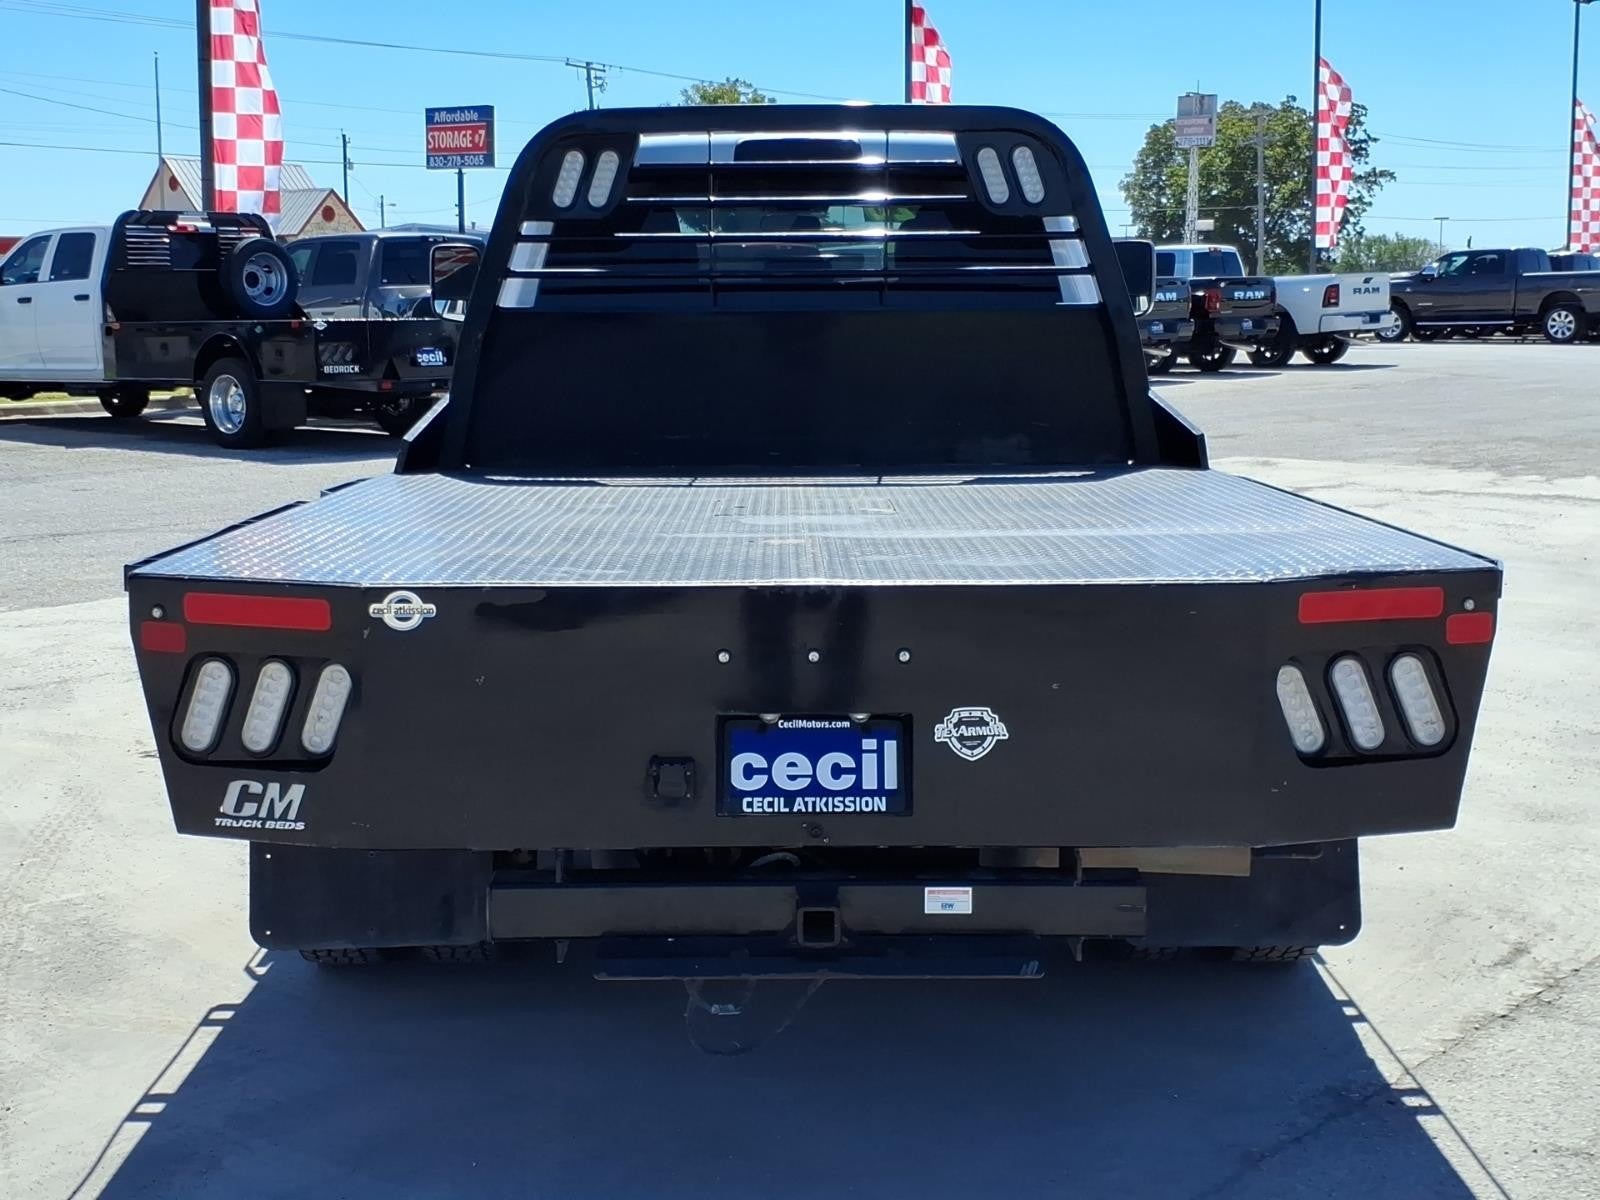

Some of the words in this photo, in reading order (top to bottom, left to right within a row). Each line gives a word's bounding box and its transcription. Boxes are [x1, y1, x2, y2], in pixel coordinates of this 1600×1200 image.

[434, 110, 479, 123] Affordable
[428, 130, 473, 149] STORAGE
[1155, 292, 1177, 301] AM
[1234, 291, 1265, 300] RAM
[1352, 287, 1380, 295] RAM
[416, 350, 444, 362] cecil
[323, 365, 360, 374] BEDROCK
[371, 605, 392, 615] cecil
[393, 605, 435, 615] atkission
[778, 719, 850, 729] CecilMotors.com
[730, 738, 898, 791] cecil
[222, 780, 306, 821] CM
[742, 797, 789, 812] CECIL
[793, 797, 886, 812] ATKISSION
[214, 818, 263, 829] TRUCK
[264, 820, 306, 831] BEDS
